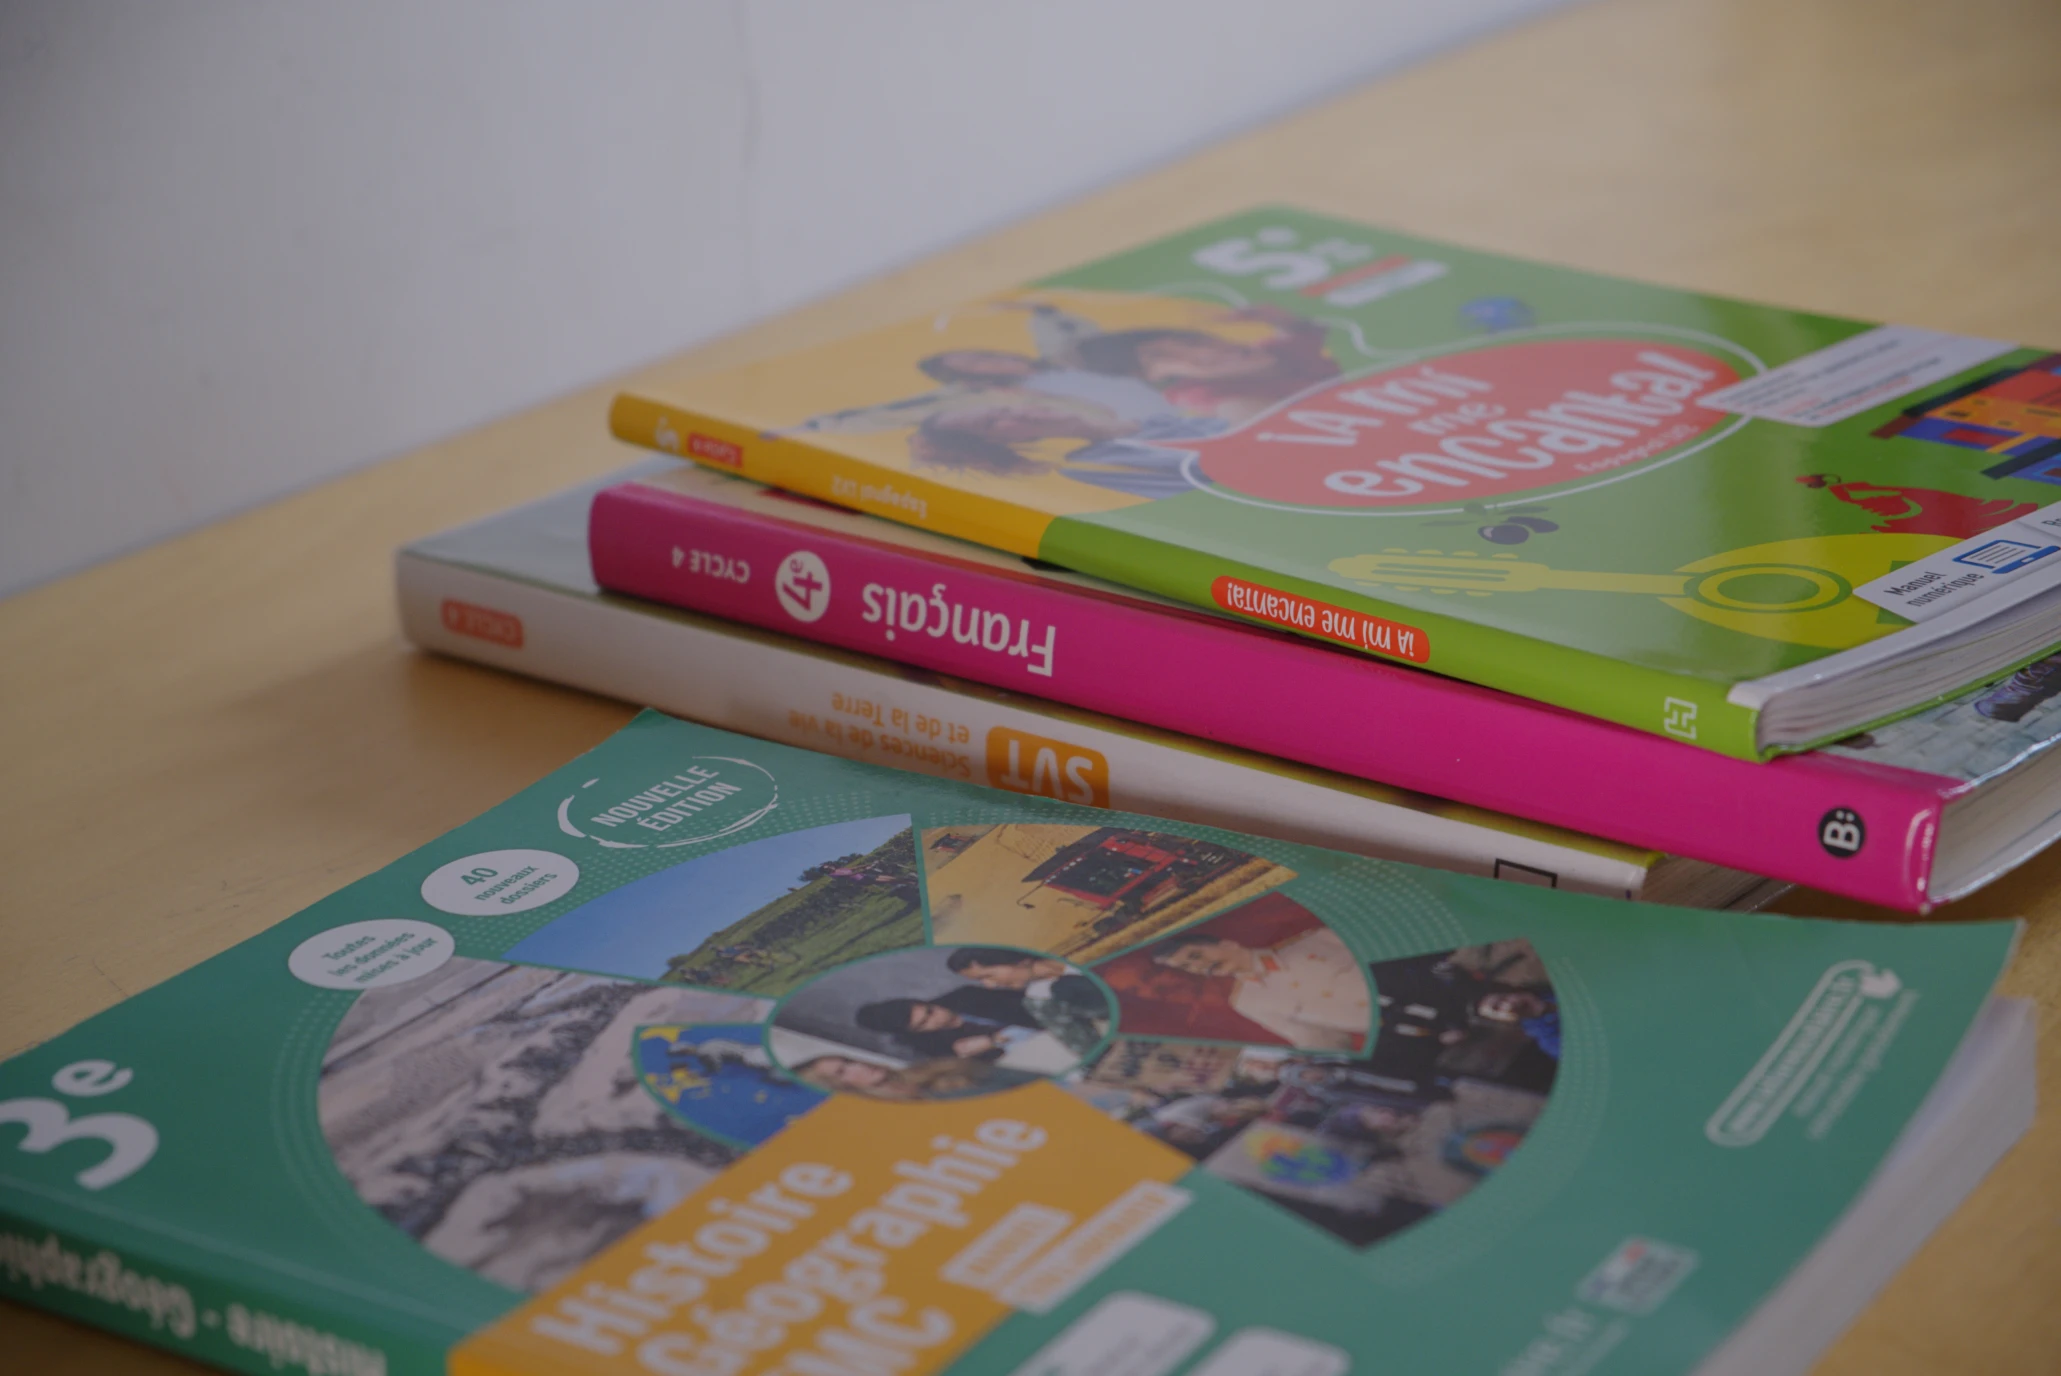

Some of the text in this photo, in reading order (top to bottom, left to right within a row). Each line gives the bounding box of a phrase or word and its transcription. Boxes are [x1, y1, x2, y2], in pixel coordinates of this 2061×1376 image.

[671, 545, 751, 584] CYCLE 4
[1884, 571, 1949, 597] Manuel
[1226, 582, 1316, 628] encanta!
[1906, 571, 1985, 608] numérique
[862, 582, 1057, 678] Français
[1321, 609, 1356, 640] me
[831, 692, 970, 745] et de la Terre
[788, 709, 971, 778] Sciences de la vie
[1001, 738, 1094, 806] SVT
[590, 765, 720, 827] NOUVELLE
[636, 781, 742, 831] ÉDITION
[460, 867, 498, 887] 40
[474, 864, 539, 902] nouveaux
[500, 872, 558, 905] dossiers
[321, 935, 377, 960] Toutes
[354, 932, 415, 964] données
[402, 937, 438, 956] jour
[529, 1160, 856, 1357] Histoire
[634, 1117, 1049, 1376] Géographie
[757, 1295, 956, 1376] MC
